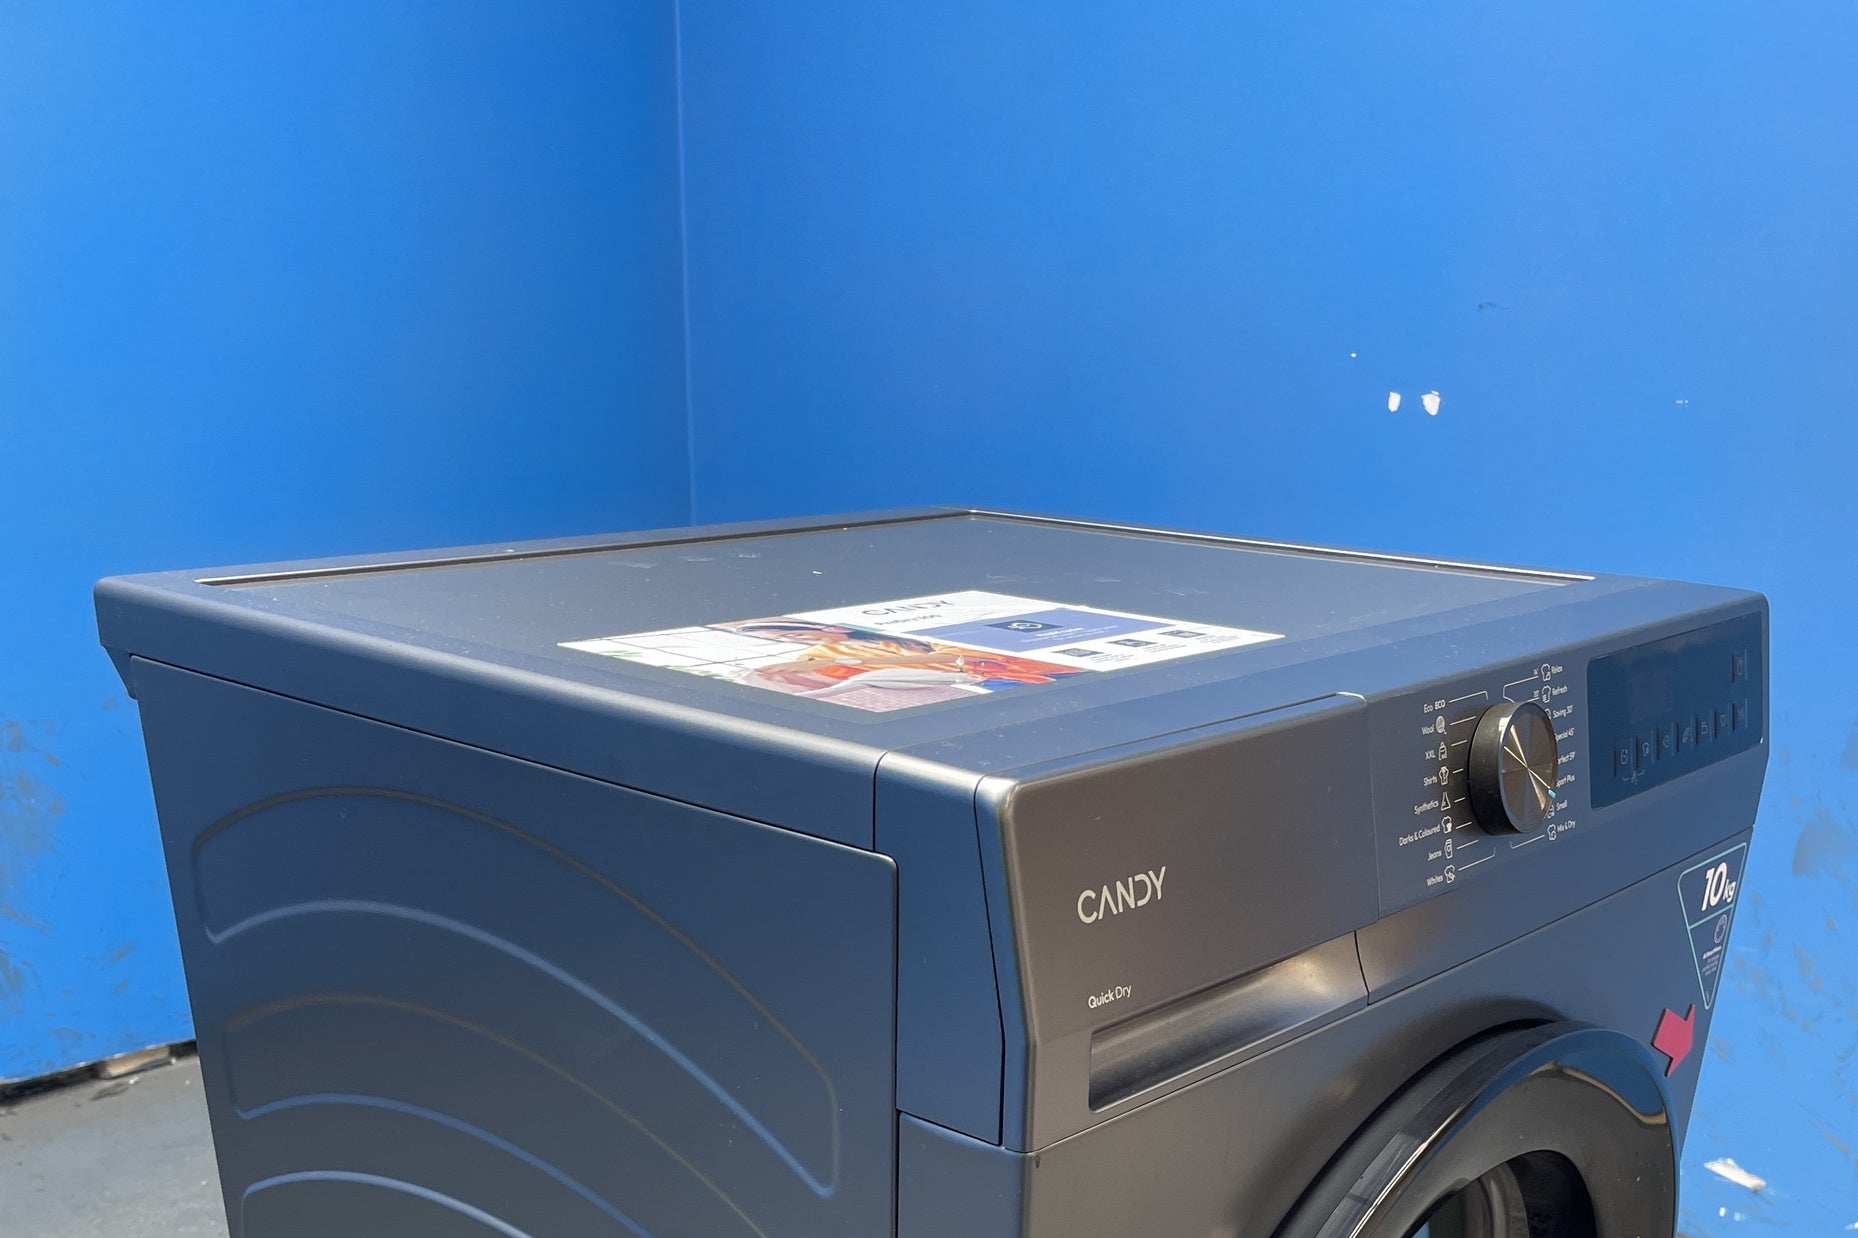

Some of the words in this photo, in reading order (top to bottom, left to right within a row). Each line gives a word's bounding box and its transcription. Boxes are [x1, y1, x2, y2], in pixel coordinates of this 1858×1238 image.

[1423, 704, 1434, 713] Eco
[1421, 724, 1435, 735] Wool
[1424, 749, 1436, 760] XXL
[1423, 776, 1438, 787] Shirts
[1414, 800, 1439, 815] Synthetics
[1556, 799, 1568, 811] Small
[1398, 834, 1413, 847] Darks
[1418, 824, 1441, 839] Coloured
[1427, 850, 1442, 861] Jeans
[1426, 875, 1444, 887] Whites
[1077, 866, 1166, 924] CANDY
[1088, 989, 1115, 1009] Quick
[1115, 985, 1132, 999] Dry
